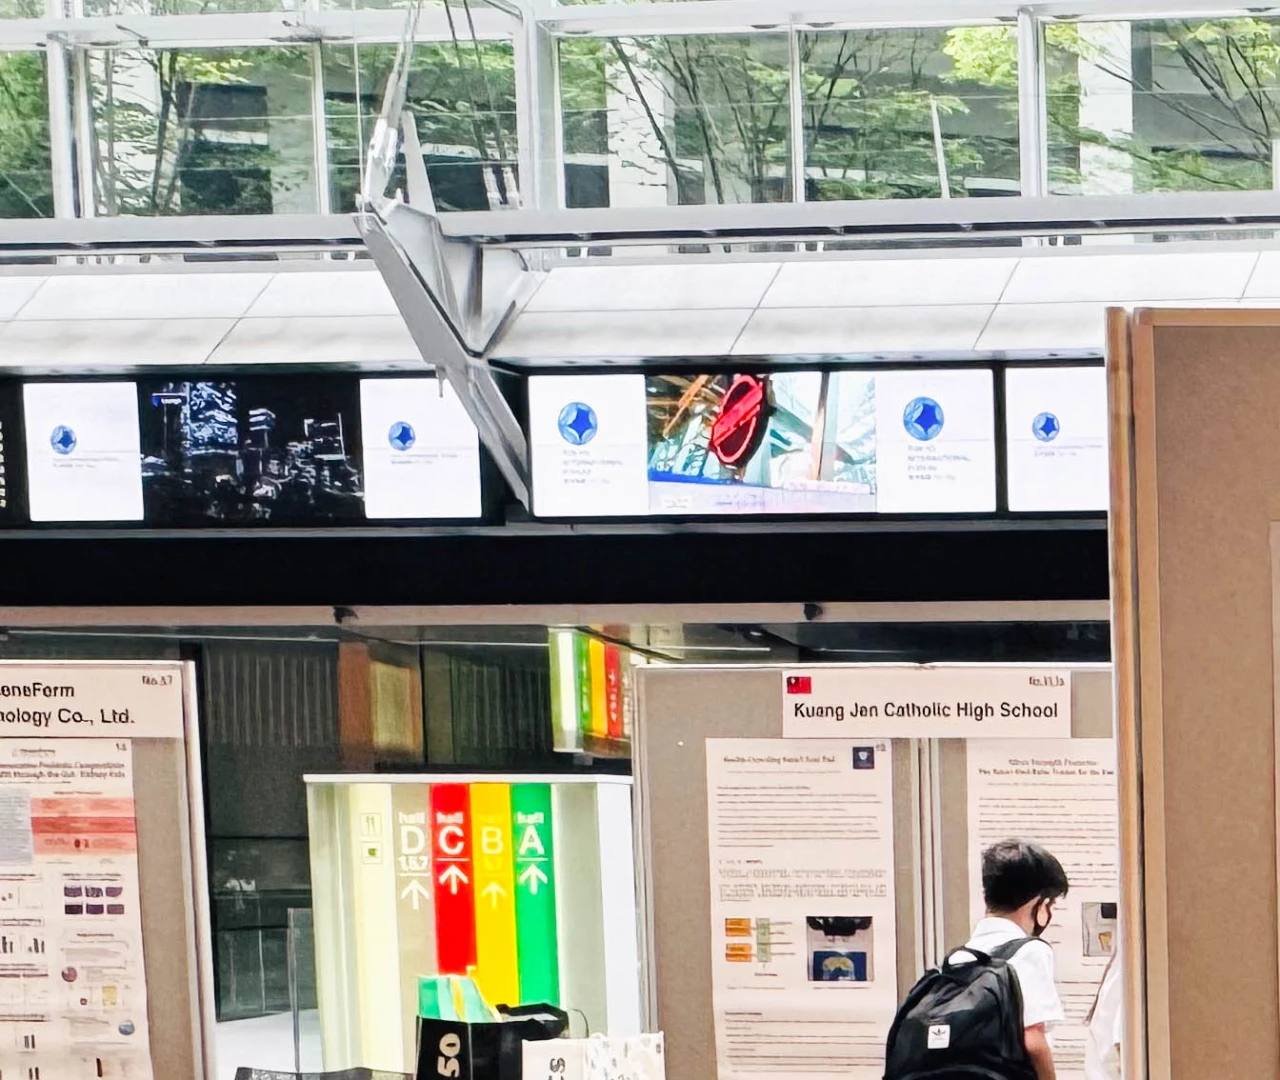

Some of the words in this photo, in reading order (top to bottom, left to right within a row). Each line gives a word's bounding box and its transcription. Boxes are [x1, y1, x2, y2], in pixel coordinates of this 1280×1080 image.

[100, 708, 136, 724] Ltd.
[793, 702, 845, 722] Kuang
[883, 701, 951, 718] Catholic
[956, 701, 995, 722] High
[999, 701, 1059, 718] School
[400, 825, 426, 855] D
[438, 825, 465, 855] C
[481, 826, 504, 855] B
[518, 825, 545, 855] A
